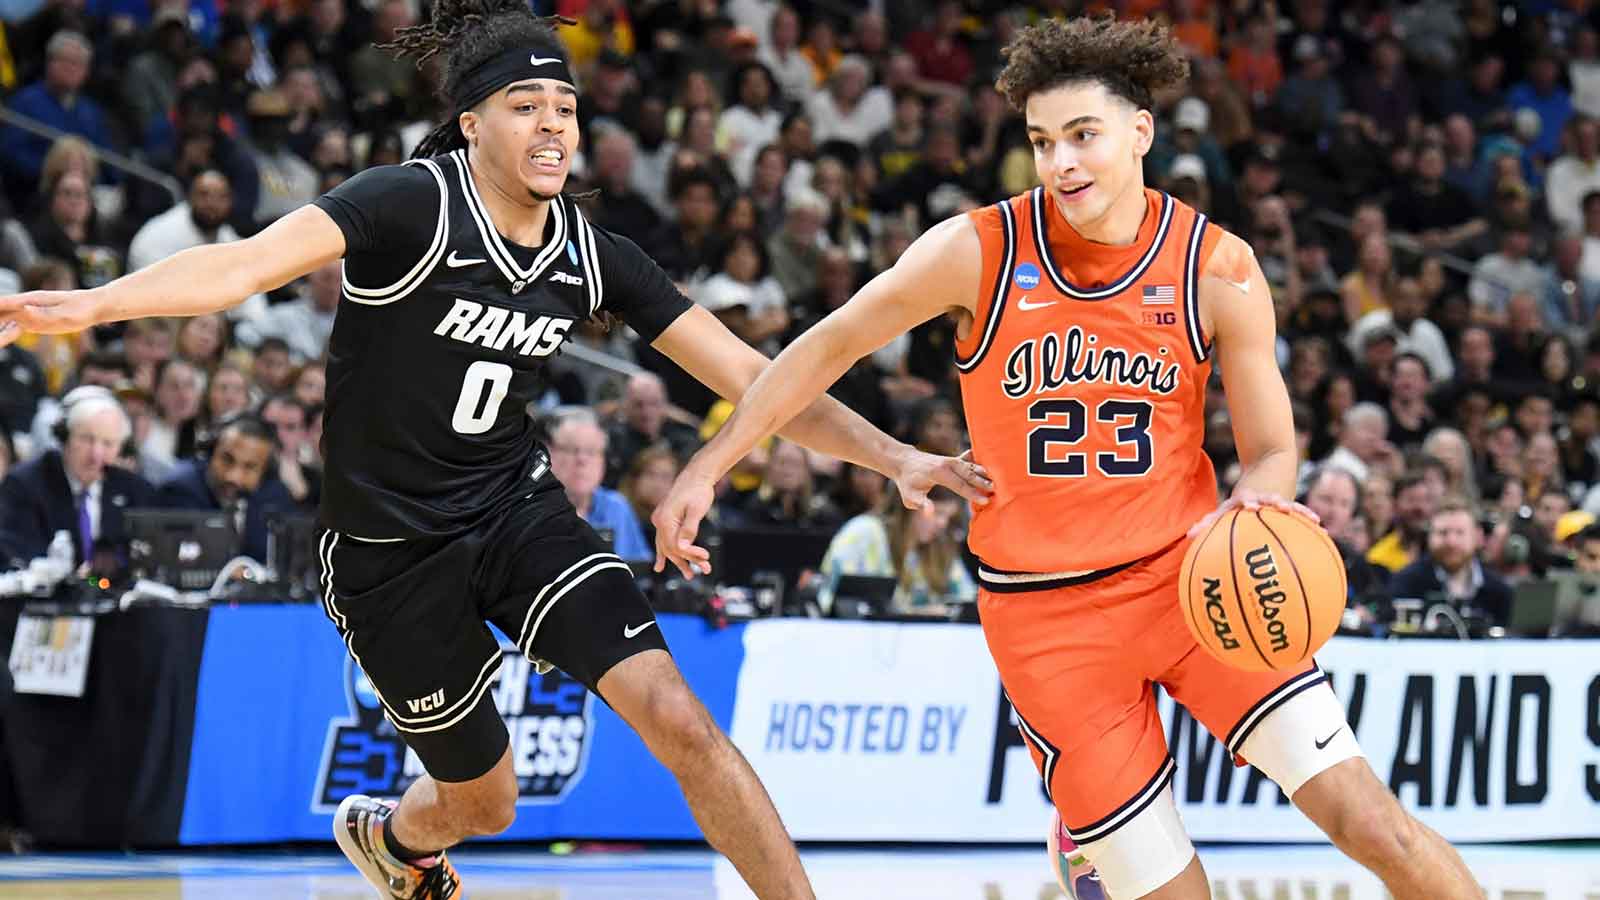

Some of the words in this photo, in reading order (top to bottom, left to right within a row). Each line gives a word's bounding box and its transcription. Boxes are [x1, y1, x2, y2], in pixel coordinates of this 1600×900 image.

[433, 298, 573, 357] RAMS
[1001, 325, 1180, 399] Illinois
[452, 361, 513, 434] 0
[1027, 398, 1153, 477] 23
[1203, 578, 1240, 650] NCAA
[1245, 544, 1289, 653] Wilson
[406, 688, 445, 713] VCU
[765, 703, 909, 752] HOSTED
[919, 704, 967, 753] BY
[1389, 674, 1551, 807] AND
